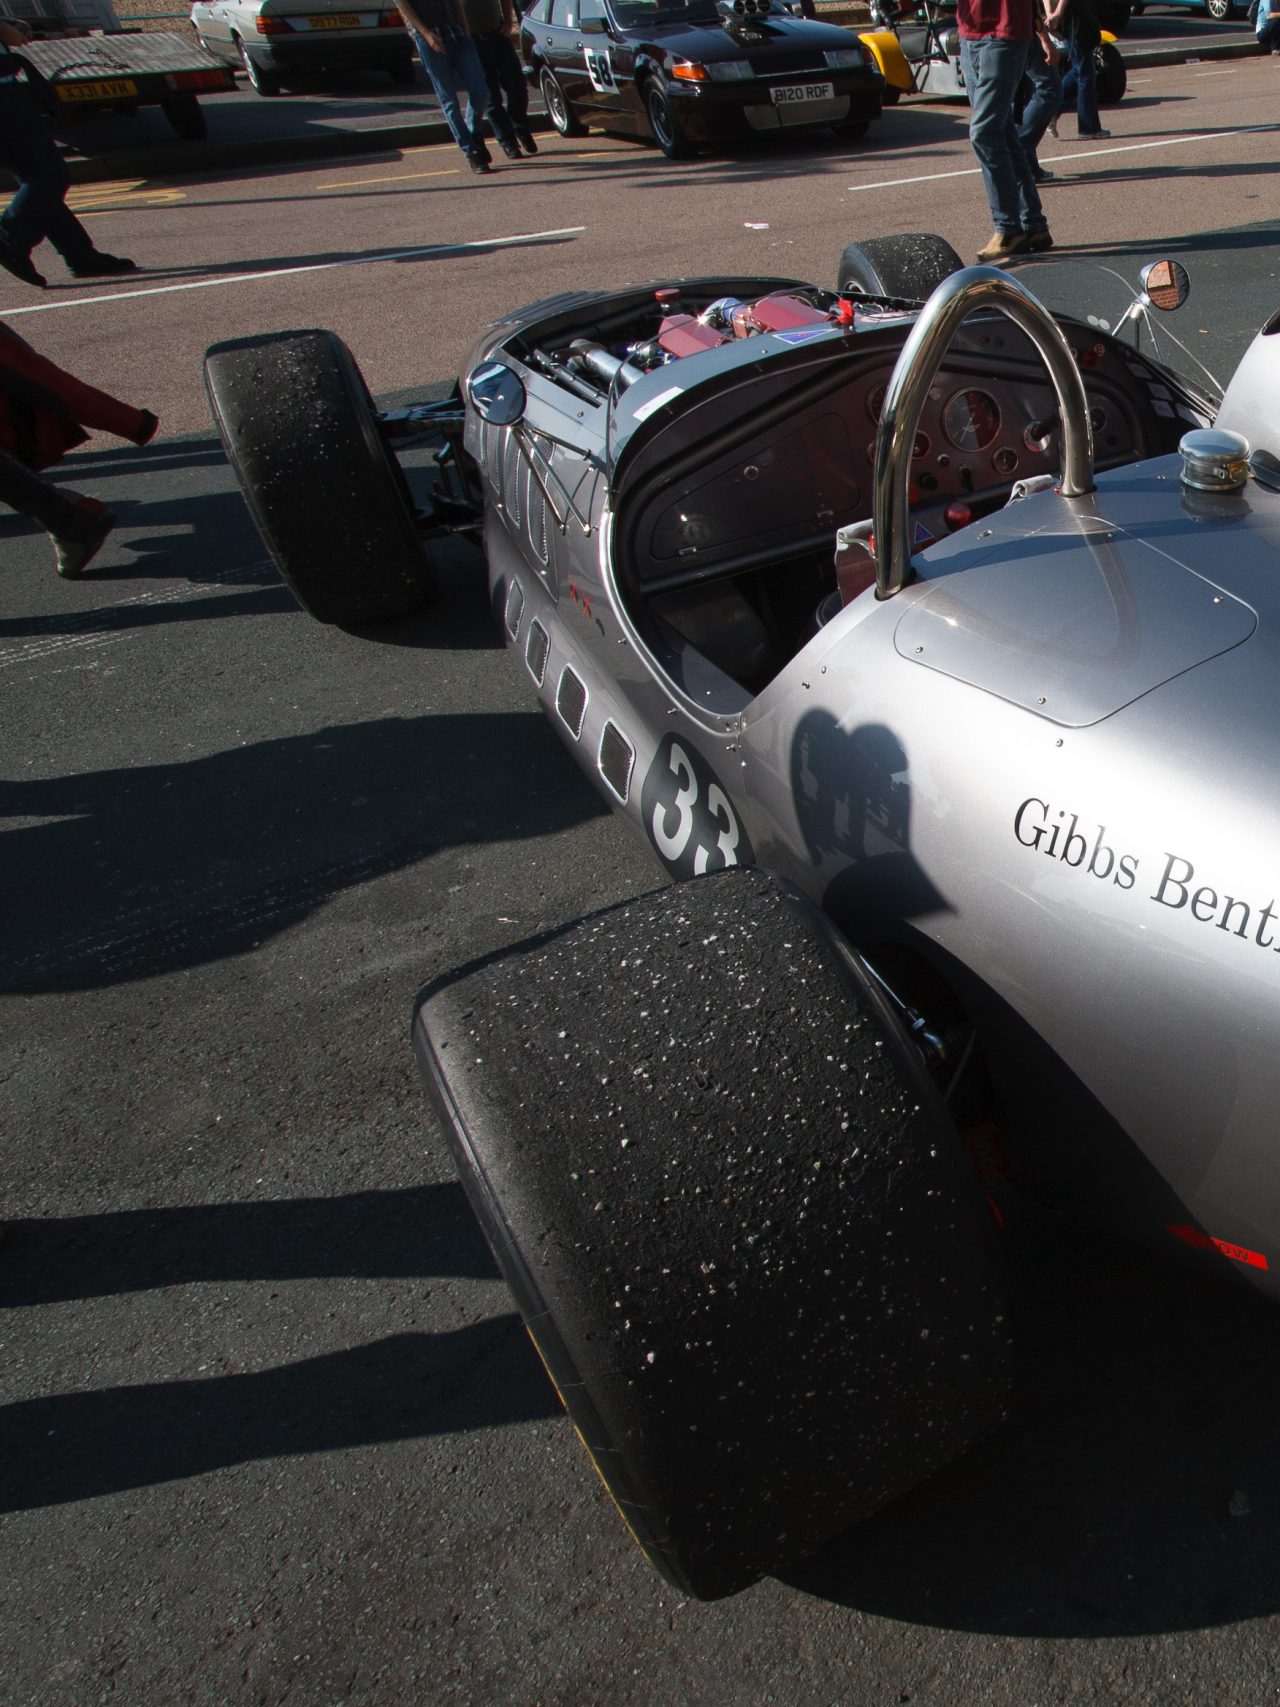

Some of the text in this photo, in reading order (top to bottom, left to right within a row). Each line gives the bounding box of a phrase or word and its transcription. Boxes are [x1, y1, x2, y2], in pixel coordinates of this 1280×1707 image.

[588, 55, 613, 87] 58
[774, 84, 830, 102] B120 RDF
[653, 743, 739, 876] 33
[1014, 797, 1140, 889] Gibbs
